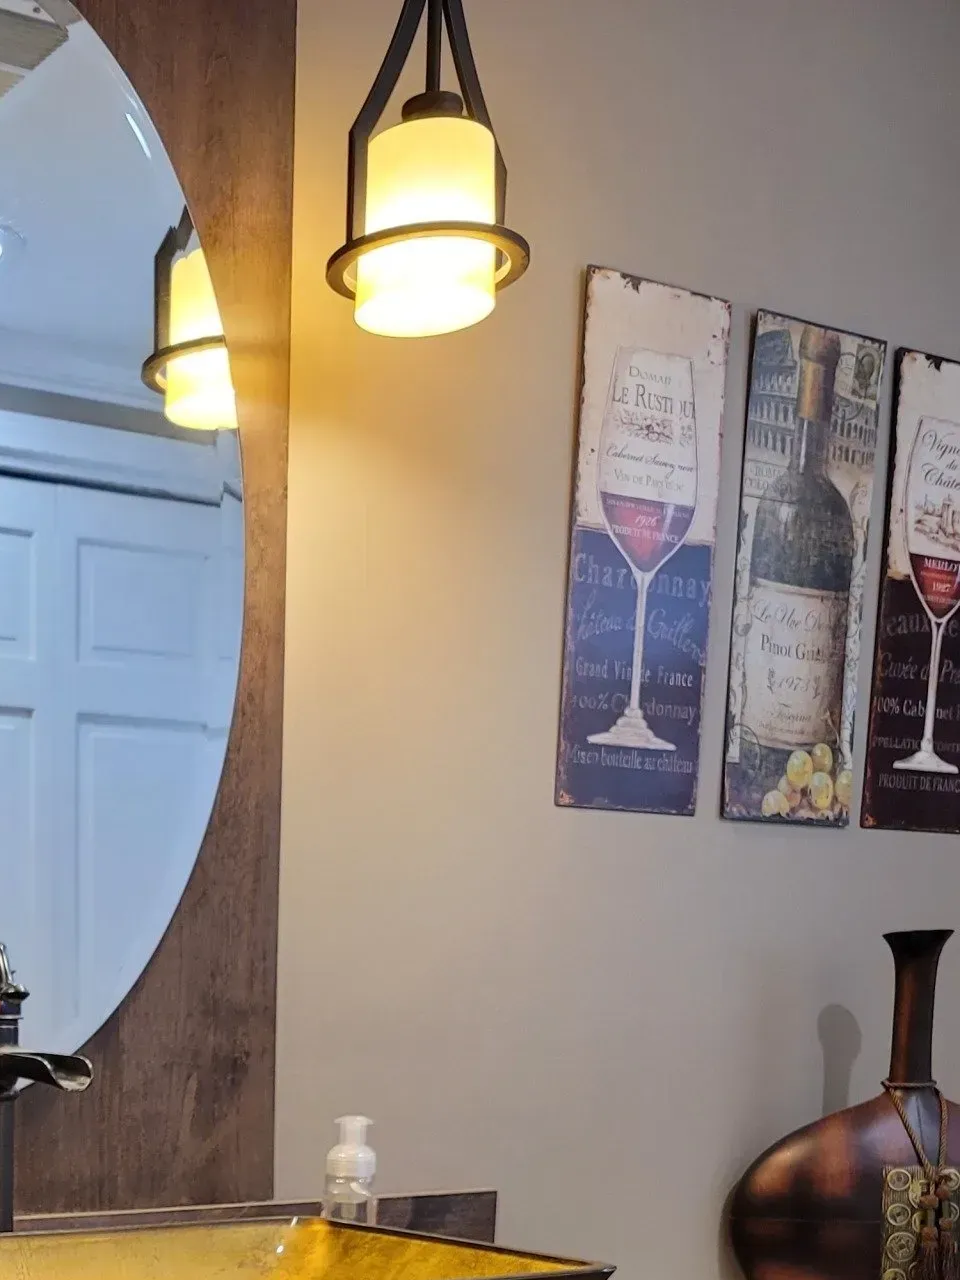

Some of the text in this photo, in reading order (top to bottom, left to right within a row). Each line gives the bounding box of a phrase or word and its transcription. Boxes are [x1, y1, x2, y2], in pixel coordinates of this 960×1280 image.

[612, 378, 696, 420] LE RUSTIU
[606, 443, 644, 462] Cabernet
[945, 459, 958, 471] du
[574, 552, 712, 608] Charnnay
[760, 633, 792, 658] Pinot
[575, 656, 609, 680] Grand
[614, 659, 633, 681] Vin
[657, 666, 694, 687] France
[878, 651, 918, 680] Cuvée
[571, 691, 697, 726] 100% Crdonnay
[902, 696, 954, 721] Cabnet
[601, 746, 642, 770] bouteille
[878, 772, 918, 791] PRODUIT
[919, 775, 931, 791] DE
